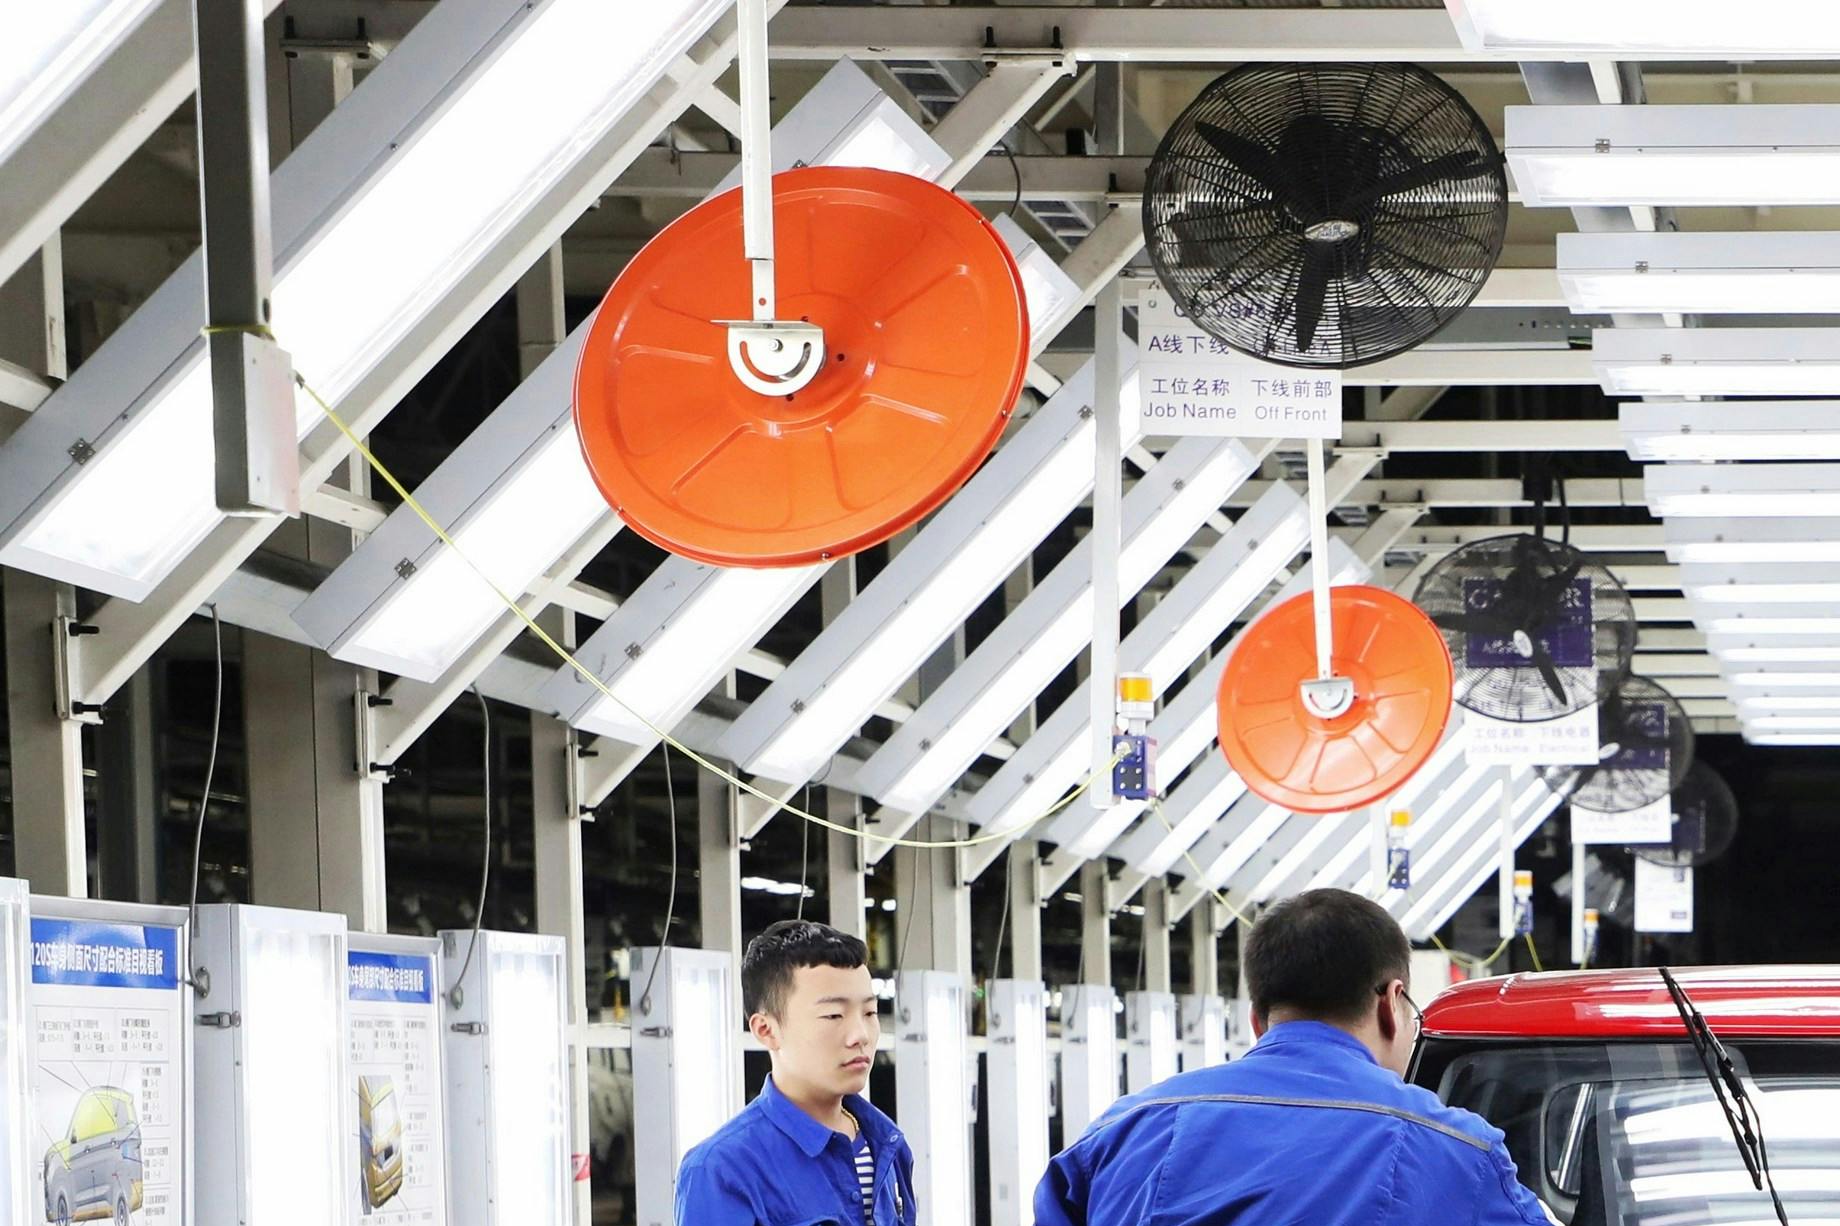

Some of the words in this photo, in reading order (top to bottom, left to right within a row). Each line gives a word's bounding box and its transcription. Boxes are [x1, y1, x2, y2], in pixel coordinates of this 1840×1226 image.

[1149, 334, 1230, 355] A线下线
[1151, 377, 1230, 397] 工位名称
[1251, 378, 1332, 399] 下线前部
[1144, 402, 1177, 418] Job
[1183, 403, 1237, 420] Name
[1254, 405, 1280, 420] Off
[1284, 406, 1327, 421] Front
